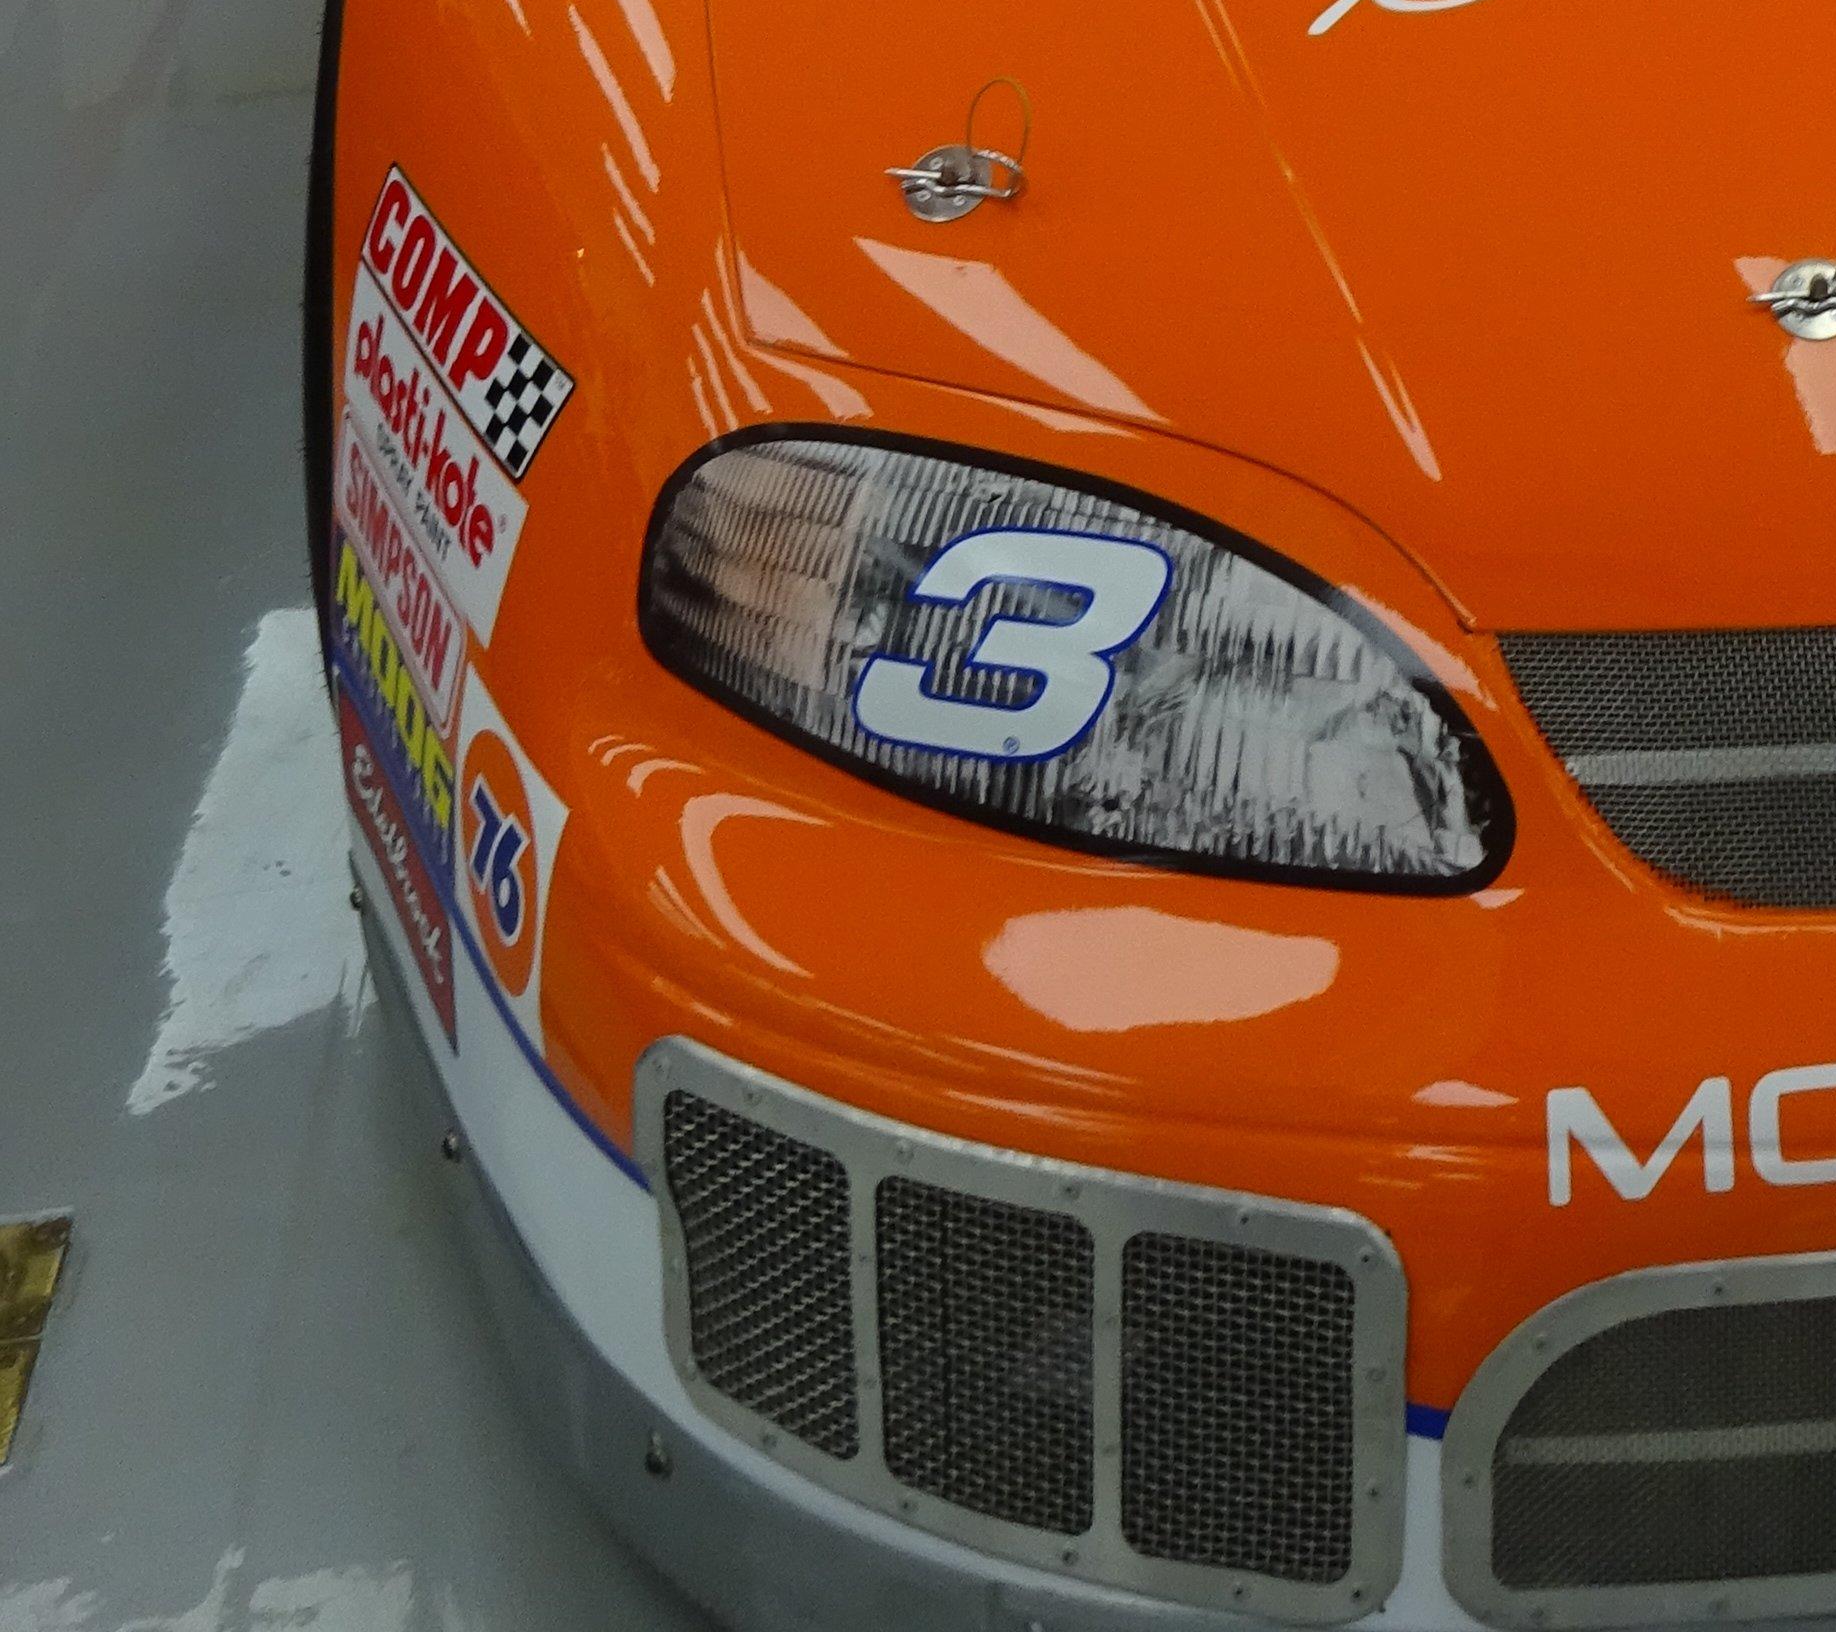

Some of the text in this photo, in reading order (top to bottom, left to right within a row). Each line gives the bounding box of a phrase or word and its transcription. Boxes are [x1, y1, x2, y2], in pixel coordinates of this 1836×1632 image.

[369, 179, 509, 393] COMP
[353, 311, 497, 571] plasti-kote
[335, 539, 455, 831] MOOG
[343, 440, 453, 694] SIMPSON
[852, 524, 1176, 765] 3
[468, 772, 531, 949] 76
